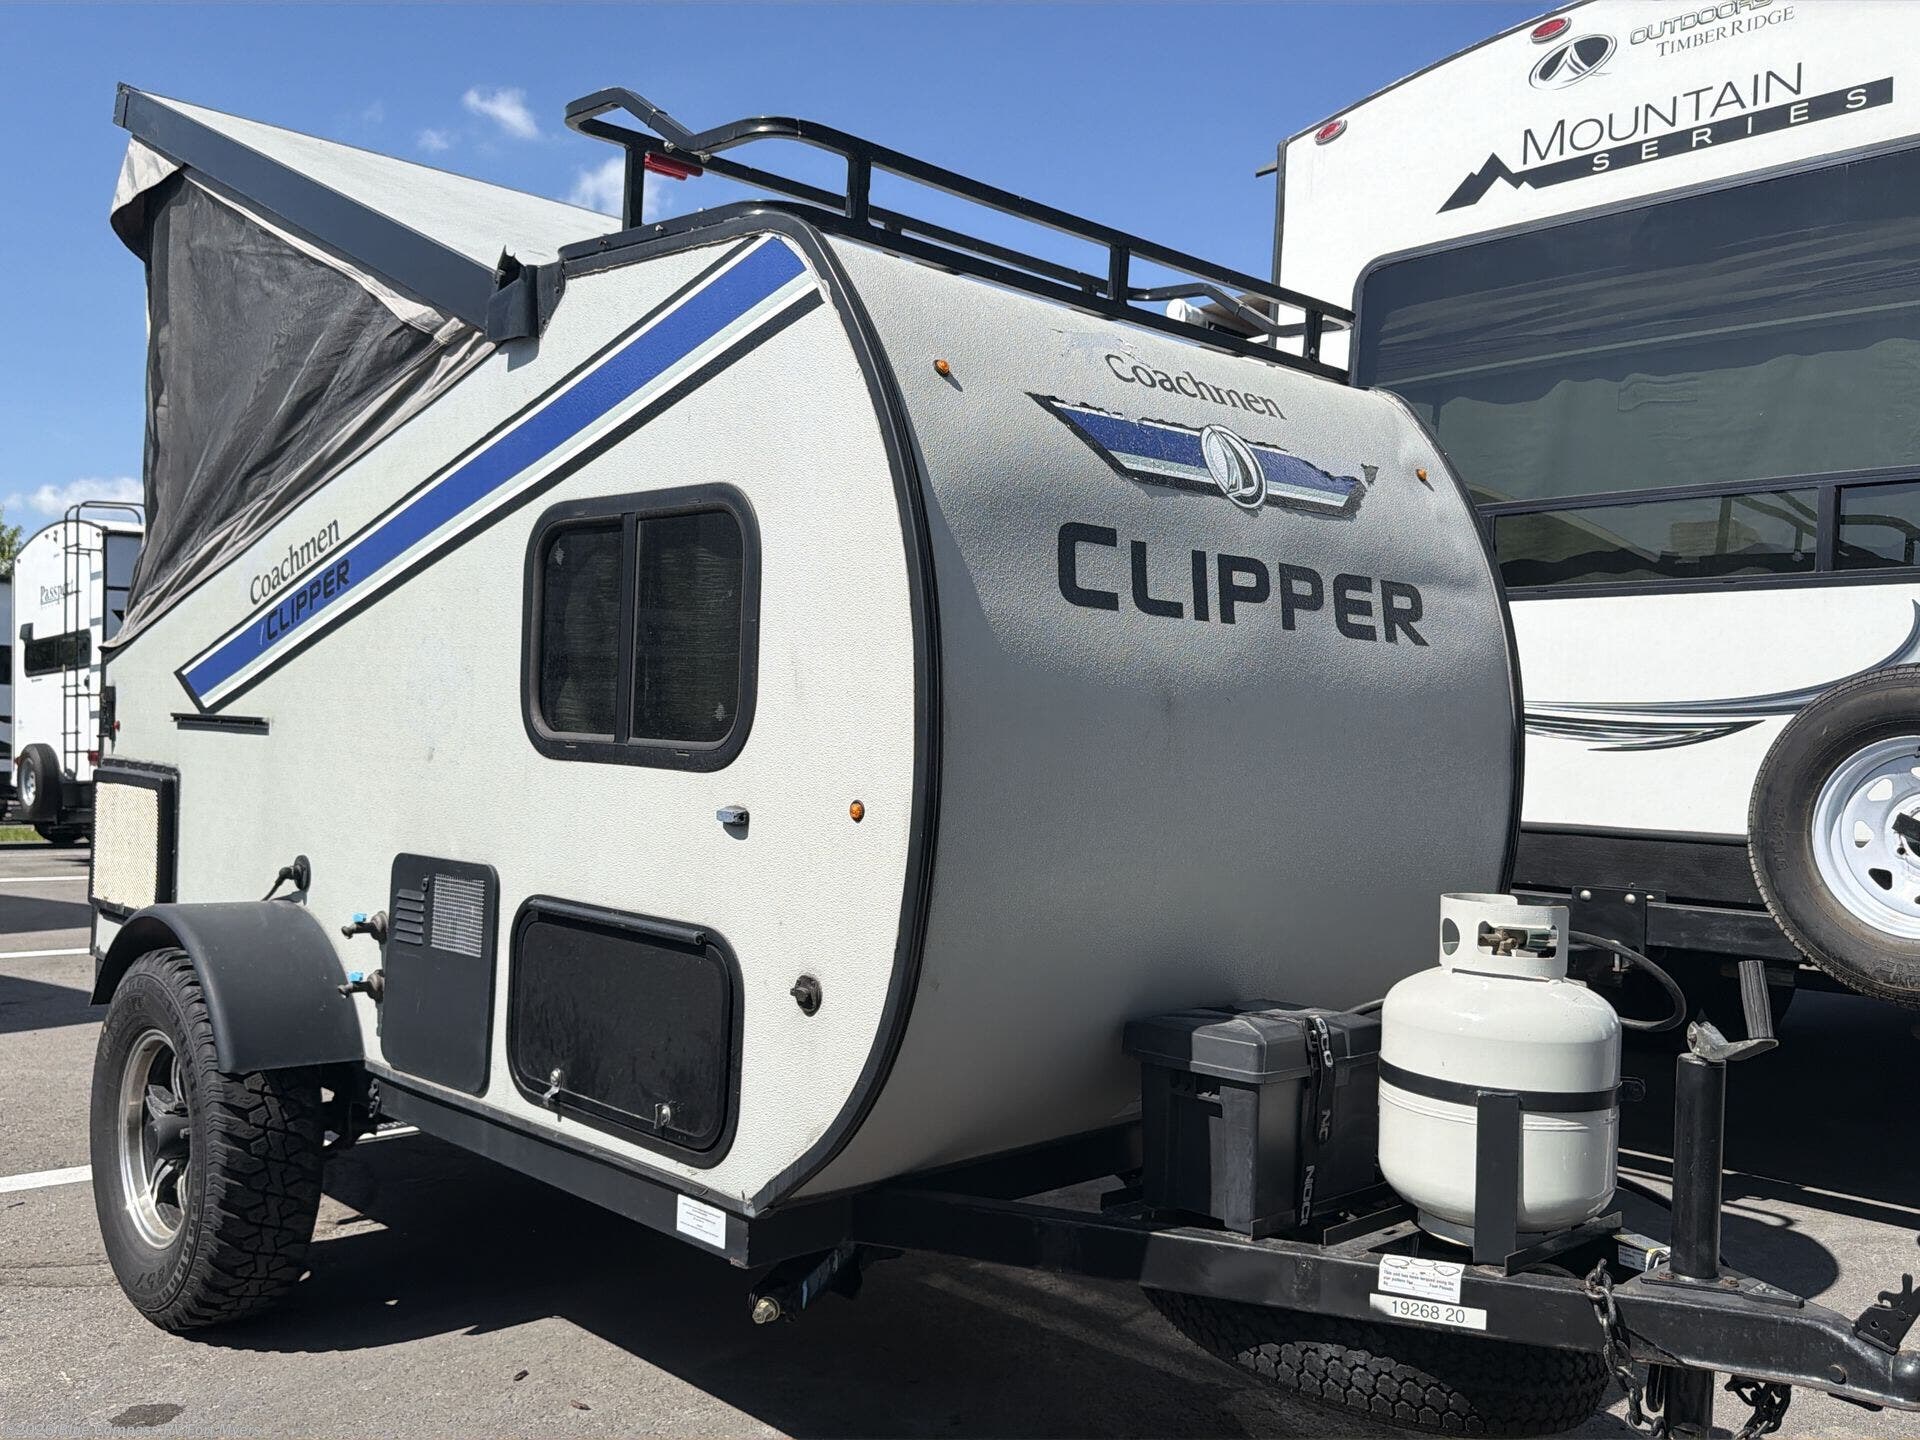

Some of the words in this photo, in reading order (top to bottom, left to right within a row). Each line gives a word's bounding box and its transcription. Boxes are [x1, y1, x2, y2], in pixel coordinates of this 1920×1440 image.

[1522, 61, 1803, 165] MOUNTAIN
[1592, 87, 1868, 172] SERIES
[1104, 353, 1288, 420] Coachmen
[250, 519, 342, 605] Coachmen
[266, 558, 351, 641] CLIPPER
[1057, 522, 1431, 647] CLIPPER
[1391, 1299, 1440, 1321] 19268
[1445, 1308, 1466, 1325] 20
